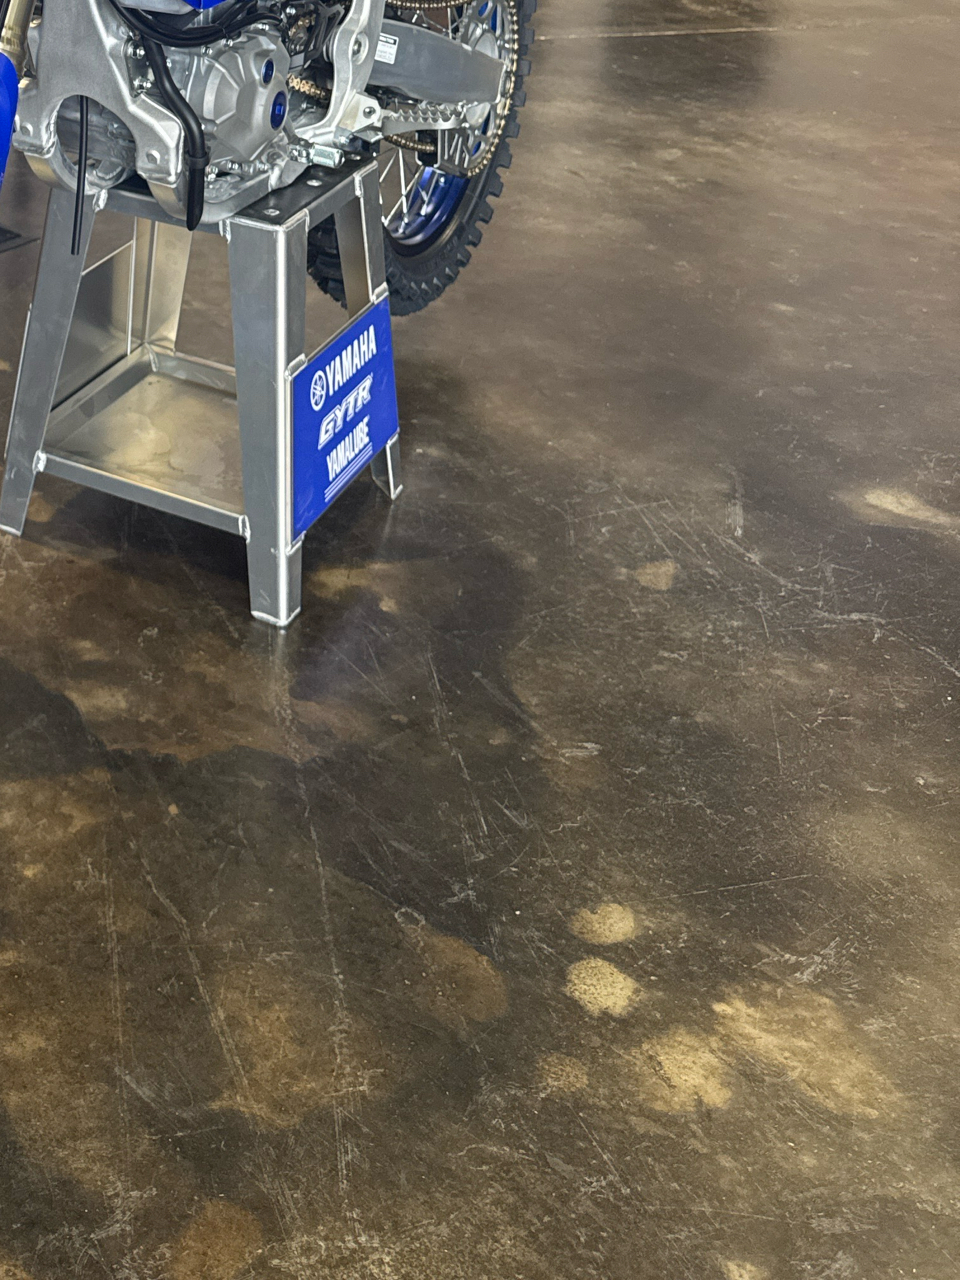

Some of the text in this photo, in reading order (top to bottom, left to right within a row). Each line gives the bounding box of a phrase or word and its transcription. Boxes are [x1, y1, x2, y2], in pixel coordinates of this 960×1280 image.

[325, 324, 377, 397] YAMAHA
[317, 373, 373, 451] GYTR
[326, 414, 371, 482] YAMALUBE
